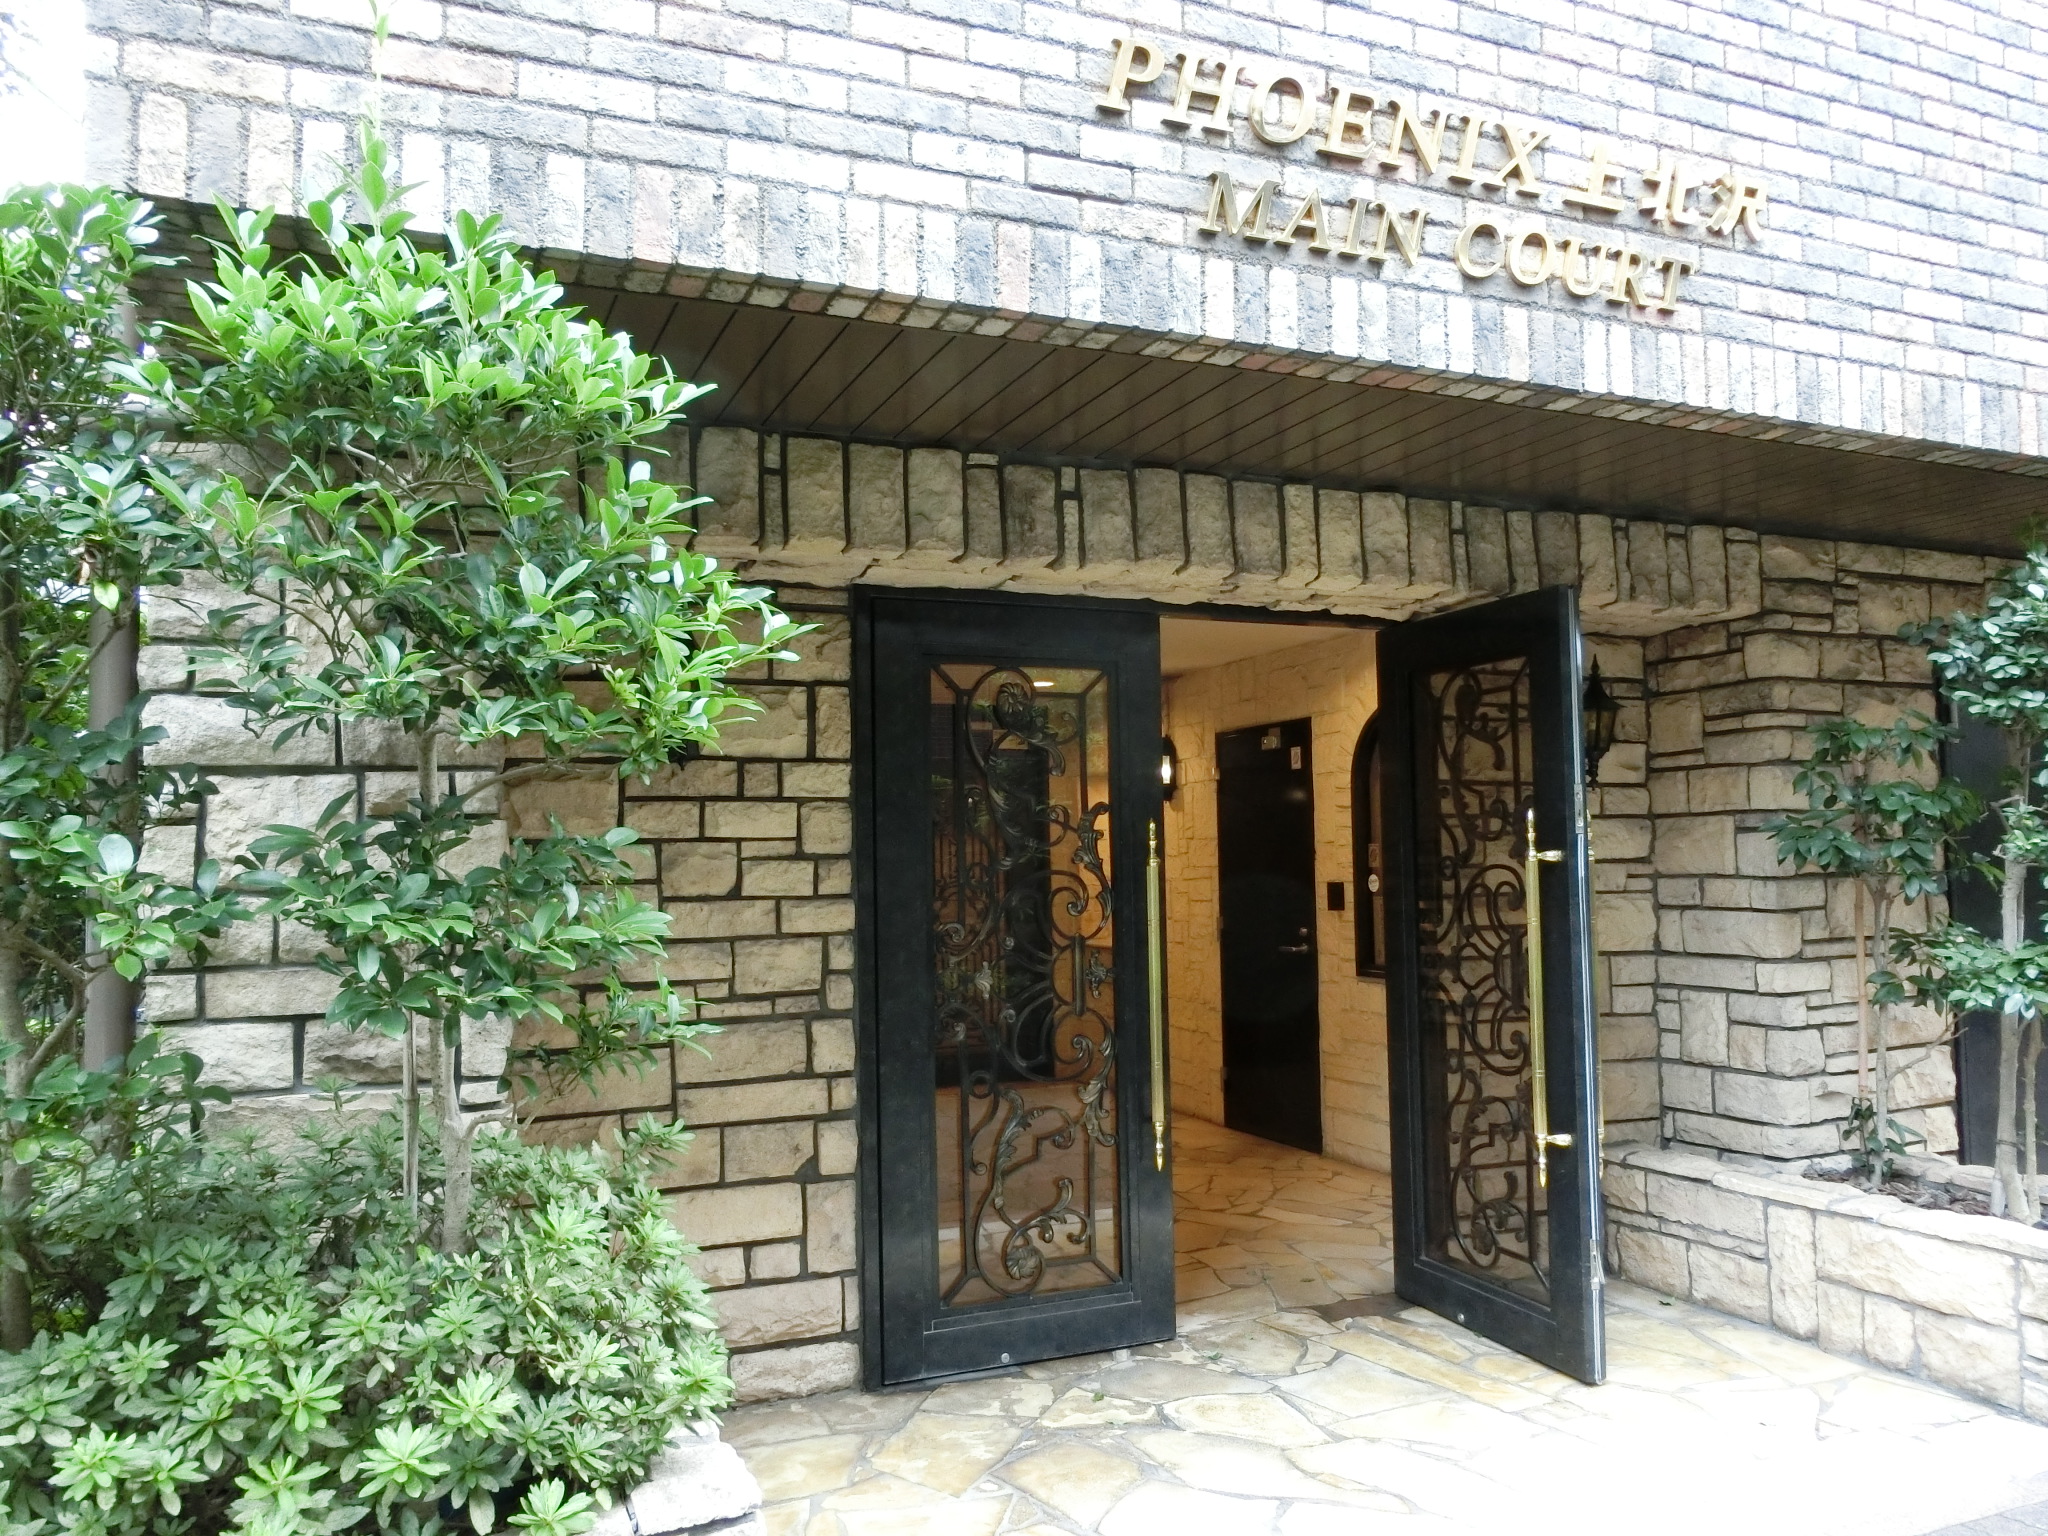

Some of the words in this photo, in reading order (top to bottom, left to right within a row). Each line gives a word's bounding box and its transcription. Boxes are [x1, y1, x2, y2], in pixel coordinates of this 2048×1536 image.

[1096, 38, 1550, 197] PHOENIX
[1562, 145, 1767, 242] 上北沢
[1199, 171, 1429, 267] MAIN
[1455, 223, 1696, 312] COURT
